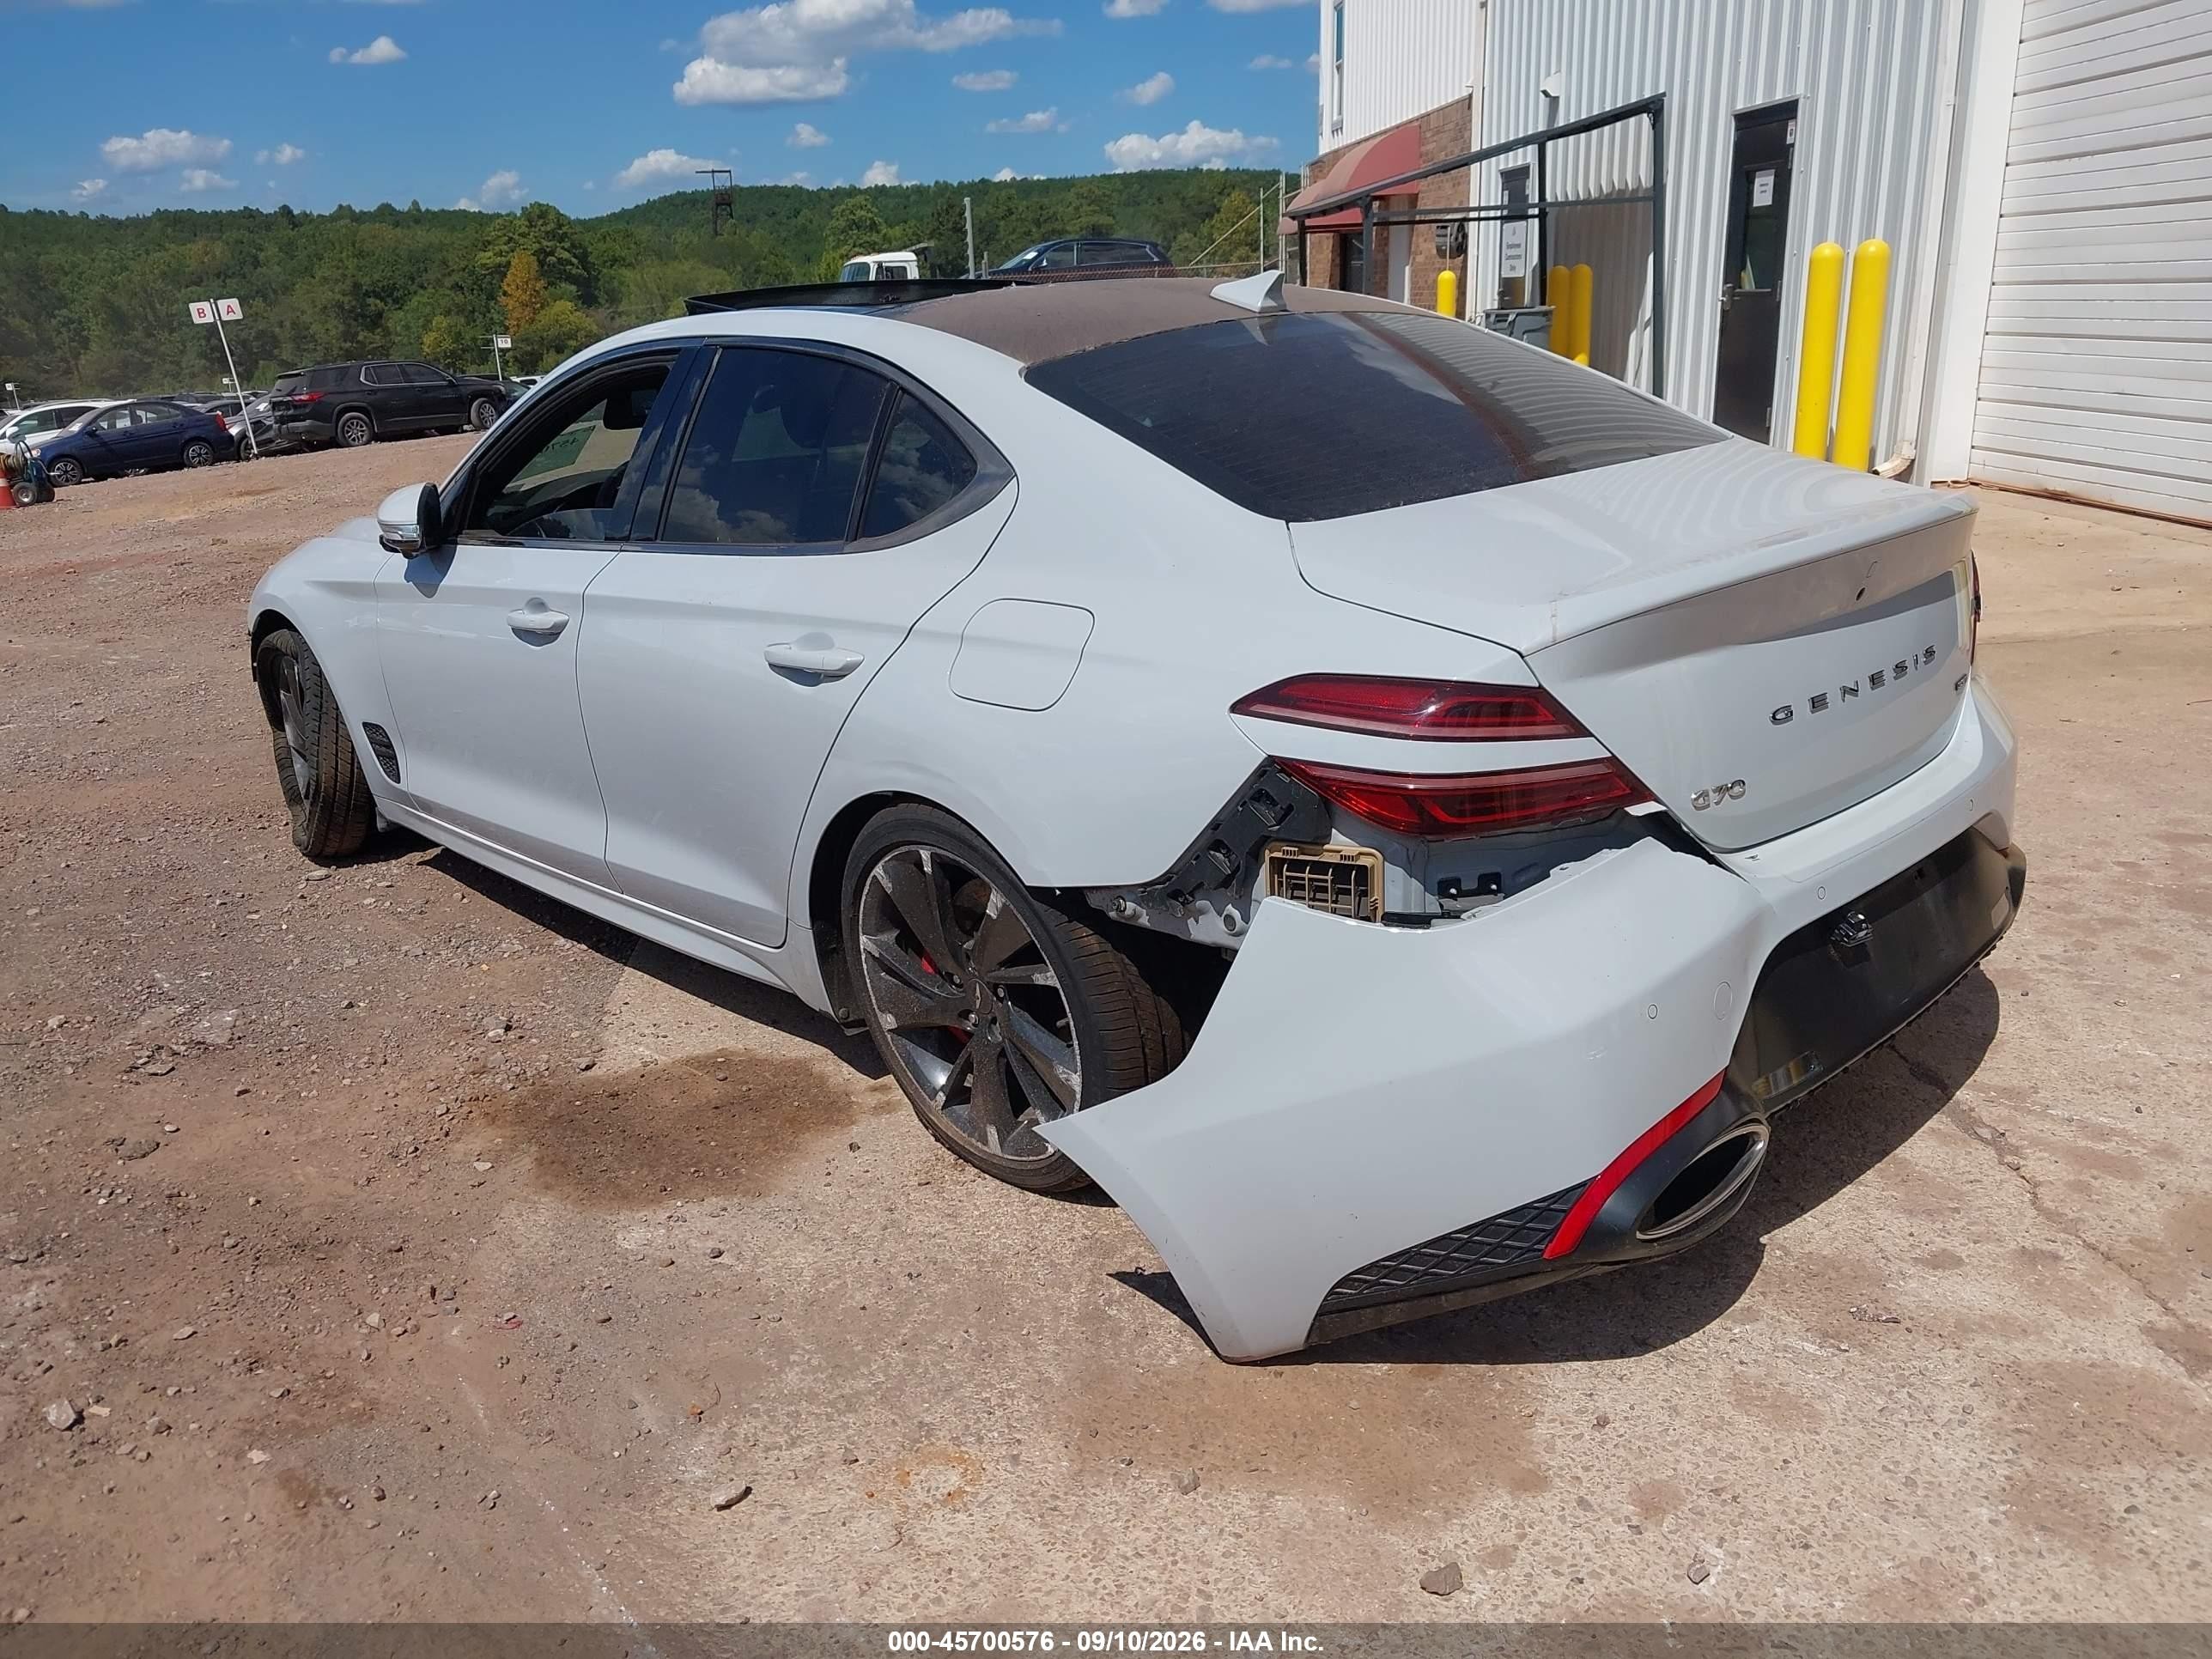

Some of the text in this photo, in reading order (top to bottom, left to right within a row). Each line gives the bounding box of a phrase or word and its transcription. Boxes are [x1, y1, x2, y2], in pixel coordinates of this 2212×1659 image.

[197, 307, 207, 319] B
[226, 304, 236, 316] A
[1769, 644, 1936, 726] GENESIS
[1691, 779, 1747, 811] G70
